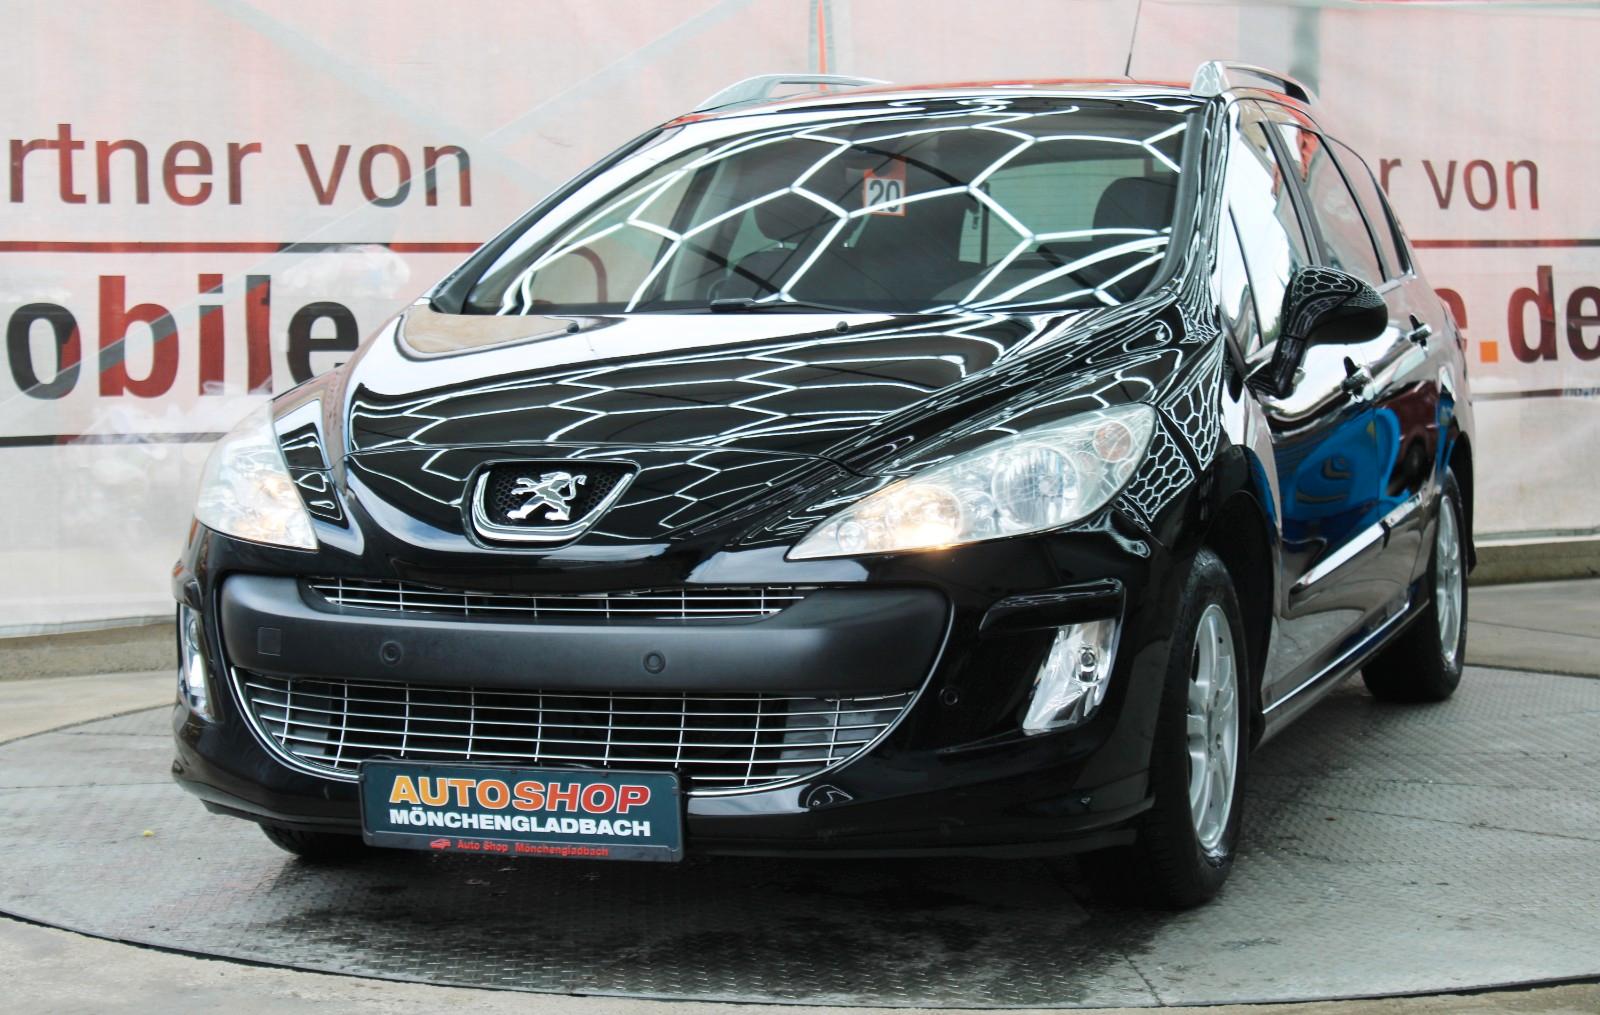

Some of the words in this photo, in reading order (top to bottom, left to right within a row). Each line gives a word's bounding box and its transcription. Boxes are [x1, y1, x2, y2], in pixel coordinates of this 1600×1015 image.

[9, 123, 262, 206] rtner
[295, 143, 473, 207] von
[869, 180, 900, 212] 20
[1421, 159, 1540, 211] von
[389, 775, 651, 814] AUTOSHOP
[389, 807, 651, 837] MÖNCHENGLADBACH
[457, 840, 480, 850] Auto
[483, 841, 508, 853] Shop
